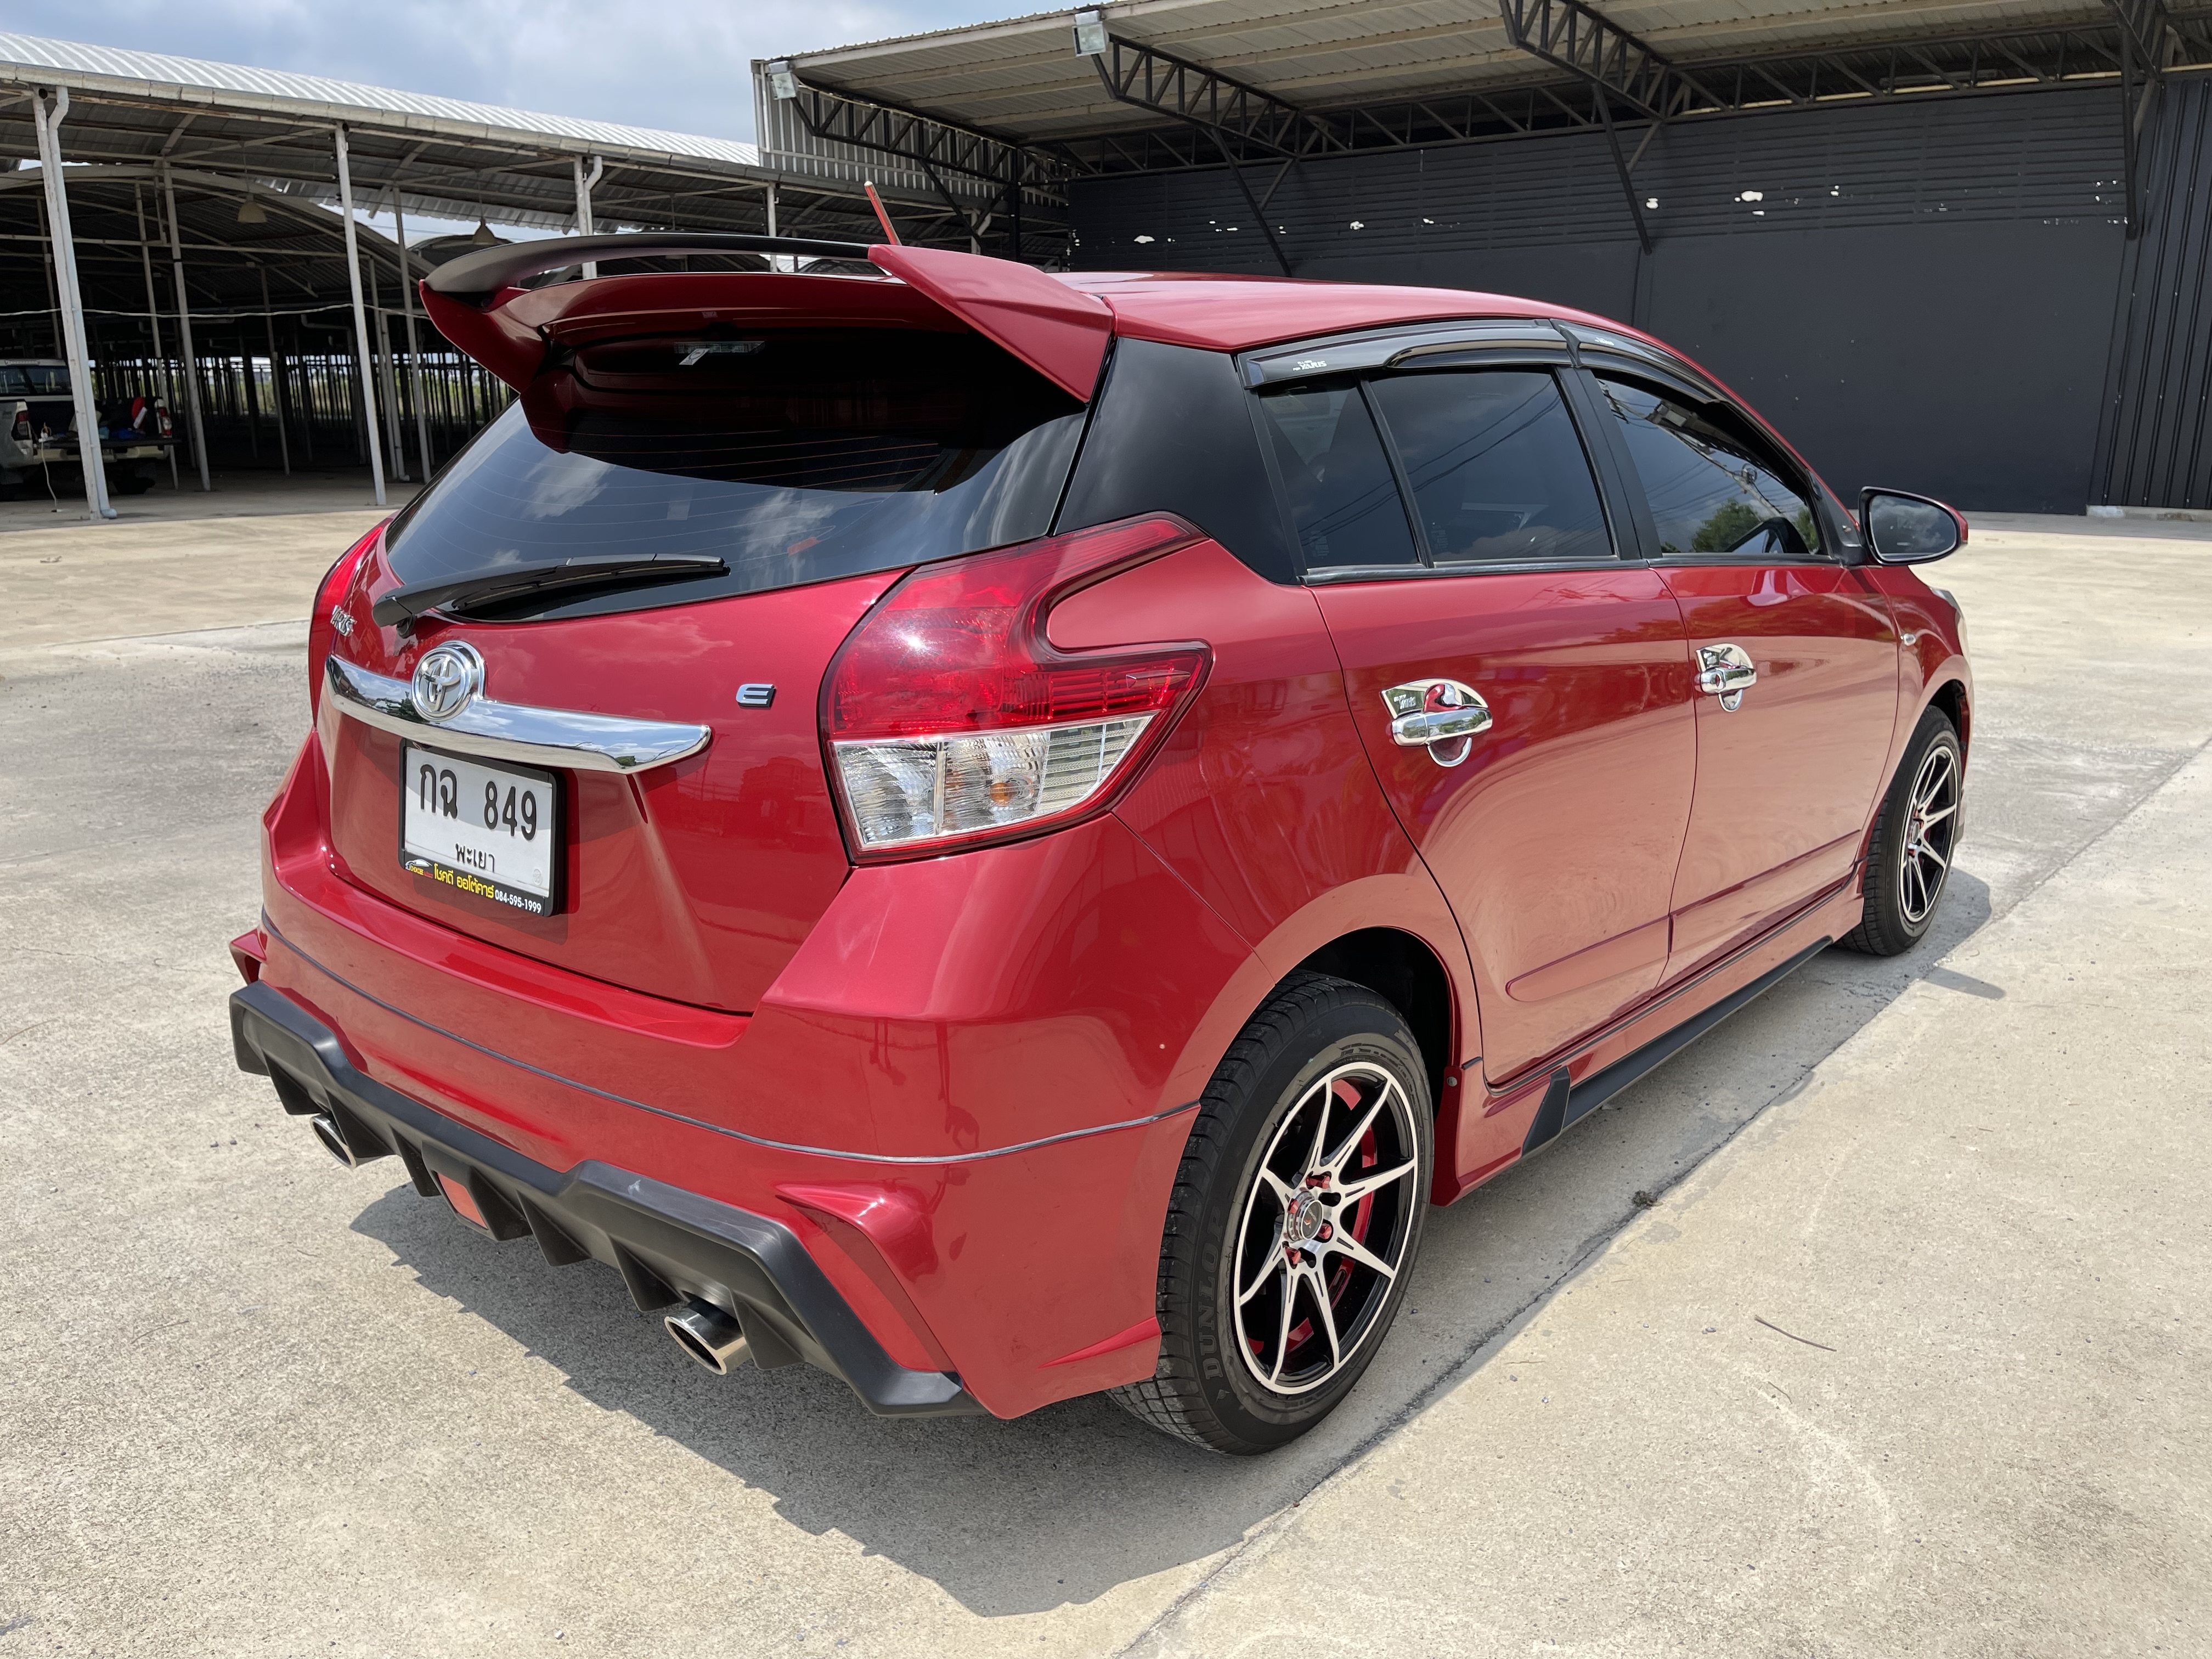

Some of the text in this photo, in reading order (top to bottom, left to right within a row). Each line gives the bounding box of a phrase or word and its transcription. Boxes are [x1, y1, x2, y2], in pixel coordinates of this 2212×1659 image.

[1299, 360, 1327, 370] YARIS
[420, 764, 537, 841] กฉ 849
[455, 843, 495, 873] พะเยา
[434, 863, 542, 914] โชคดี ออโต้คาร์ 084-595-1999
[1198, 1207, 1224, 1380] DUNLOP
